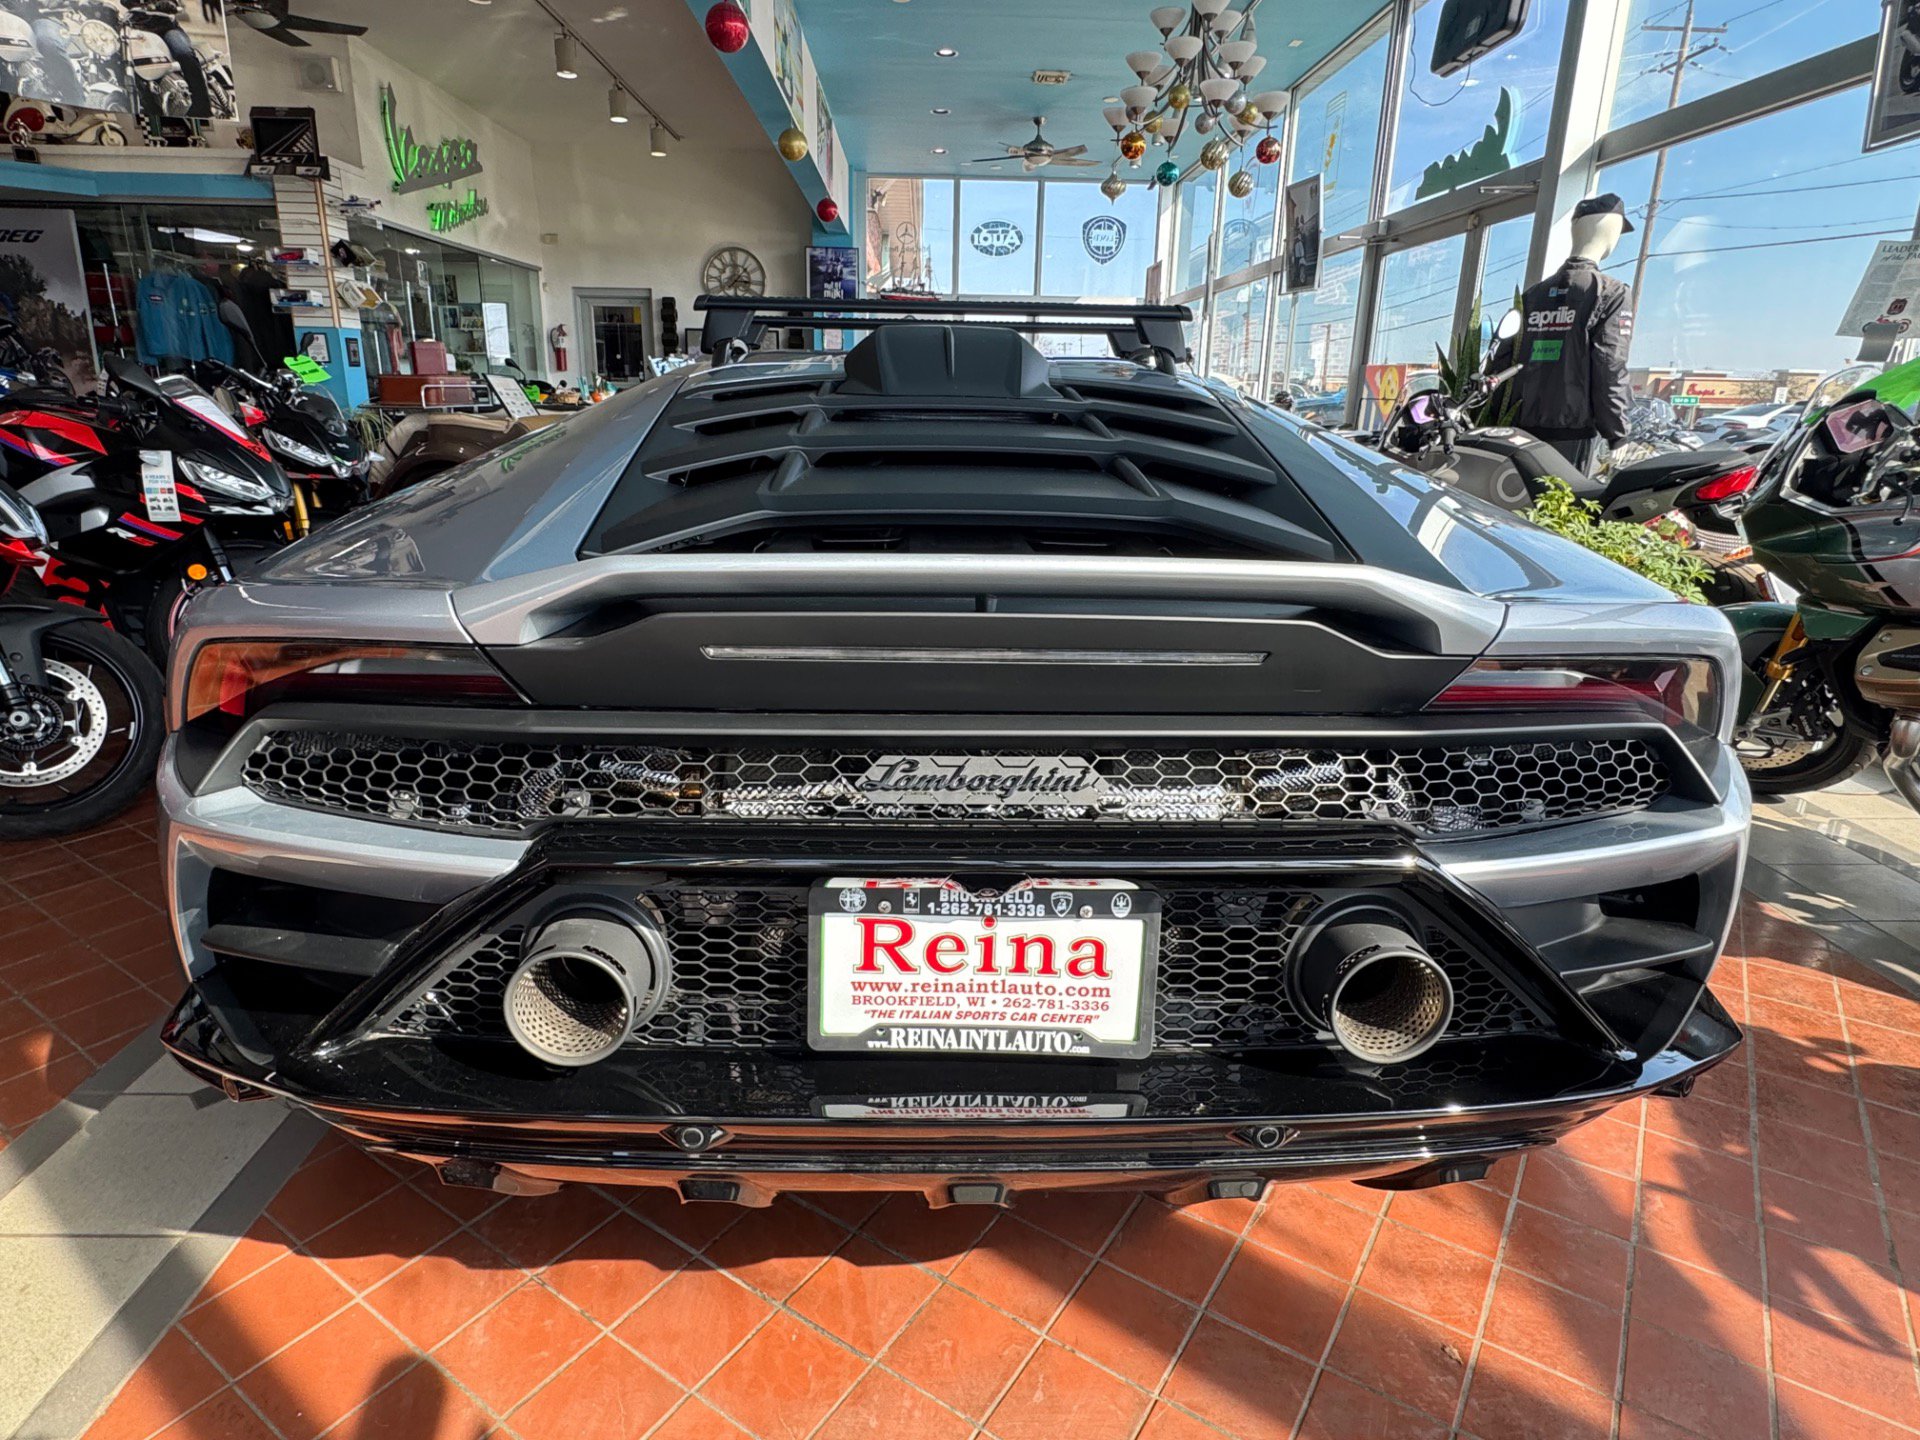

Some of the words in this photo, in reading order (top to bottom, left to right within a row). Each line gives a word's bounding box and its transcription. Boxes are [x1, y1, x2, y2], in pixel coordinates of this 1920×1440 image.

[1528, 306, 1577, 328] aprilia
[860, 757, 1092, 799] Lamborghini
[927, 902, 1046, 917] 1-262-781-3336
[854, 915, 1113, 981] Reina
[850, 978, 1112, 998] www.reinaintlauto.com
[851, 995, 961, 1009] BROOKFIELD,
[966, 996, 986, 1007] WI
[1002, 997, 1110, 1012] 262-781-3336
[899, 1010, 952, 1019] ITALIAN
[955, 1010, 1007, 1021] SPORTS
[1010, 1012, 1038, 1022] CAR
